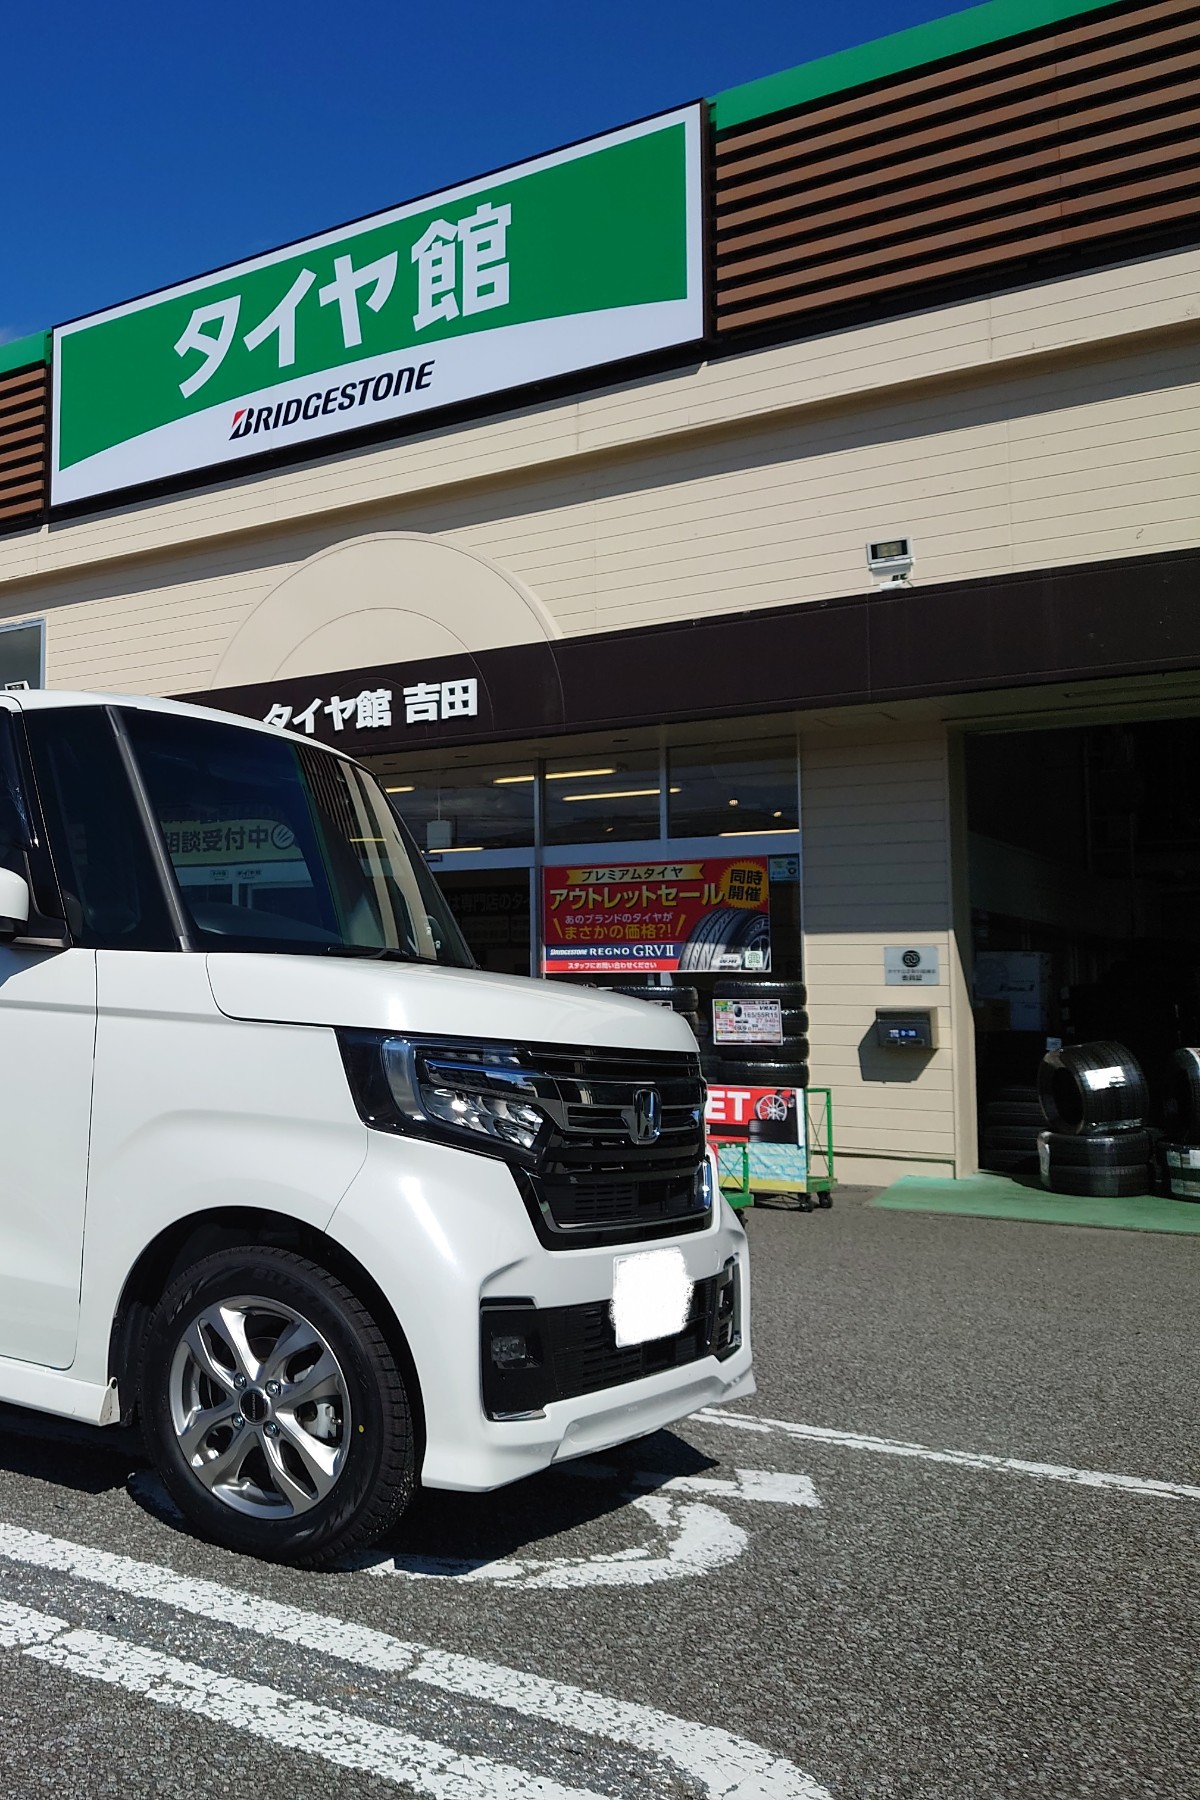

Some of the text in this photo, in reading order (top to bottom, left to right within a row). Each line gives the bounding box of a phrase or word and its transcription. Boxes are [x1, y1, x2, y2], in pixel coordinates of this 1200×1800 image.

[174, 202, 512, 399] タイヤ館
[229, 360, 435, 441] BRIDGESTONE
[262, 678, 478, 734] タイヤ館 吉田
[581, 866, 684, 881] プレミアムタイヤ
[729, 868, 763, 885] 同時
[550, 883, 724, 910] アウトレットセール
[728, 884, 762, 902] 開催
[565, 911, 673, 925] あのブランドのタイヤが
[589, 947, 630, 956] REGNO
[567, 961, 658, 970] スタッフにお問い合わせください
